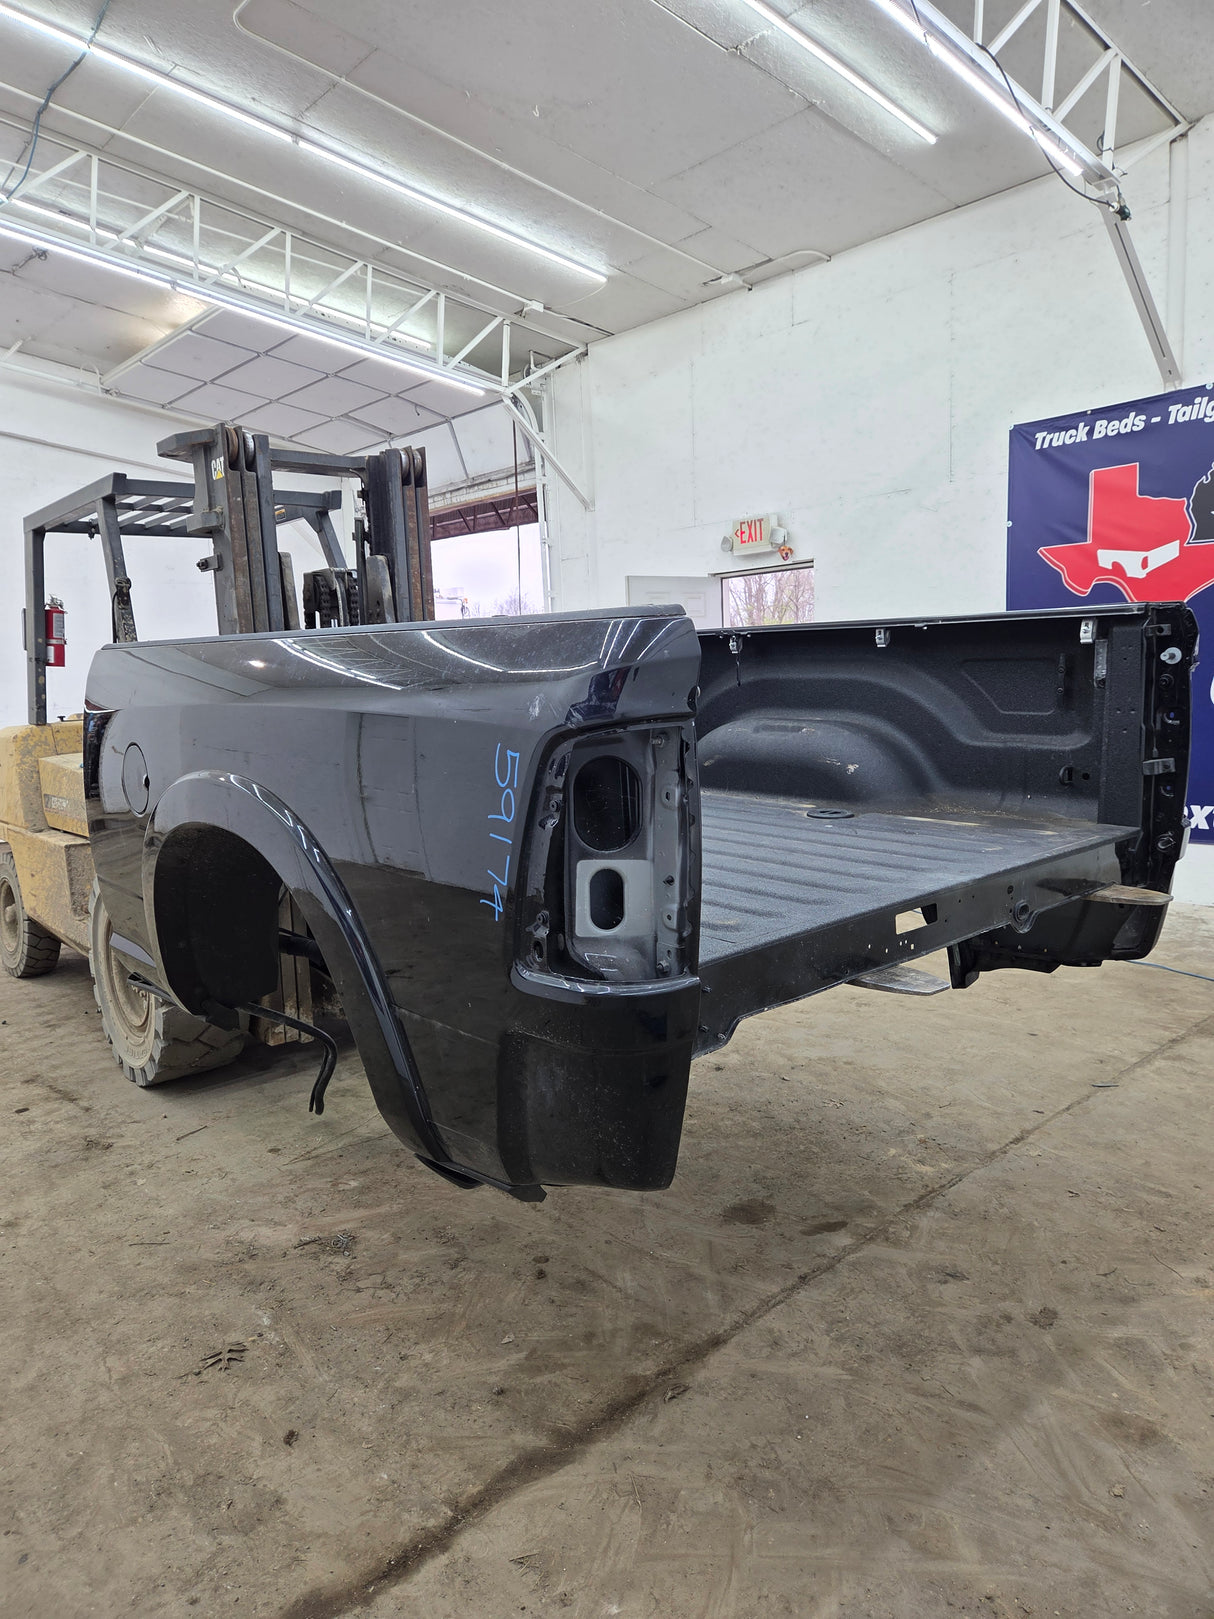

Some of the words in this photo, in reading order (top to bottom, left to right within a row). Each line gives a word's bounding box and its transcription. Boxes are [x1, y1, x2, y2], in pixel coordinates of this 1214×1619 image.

[1034, 422, 1090, 450] Truck
[1092, 411, 1147, 439] Beds
[211, 456, 224, 480] CAT
[740, 518, 764, 544] EXIT
[480, 743, 520, 921] 59174
